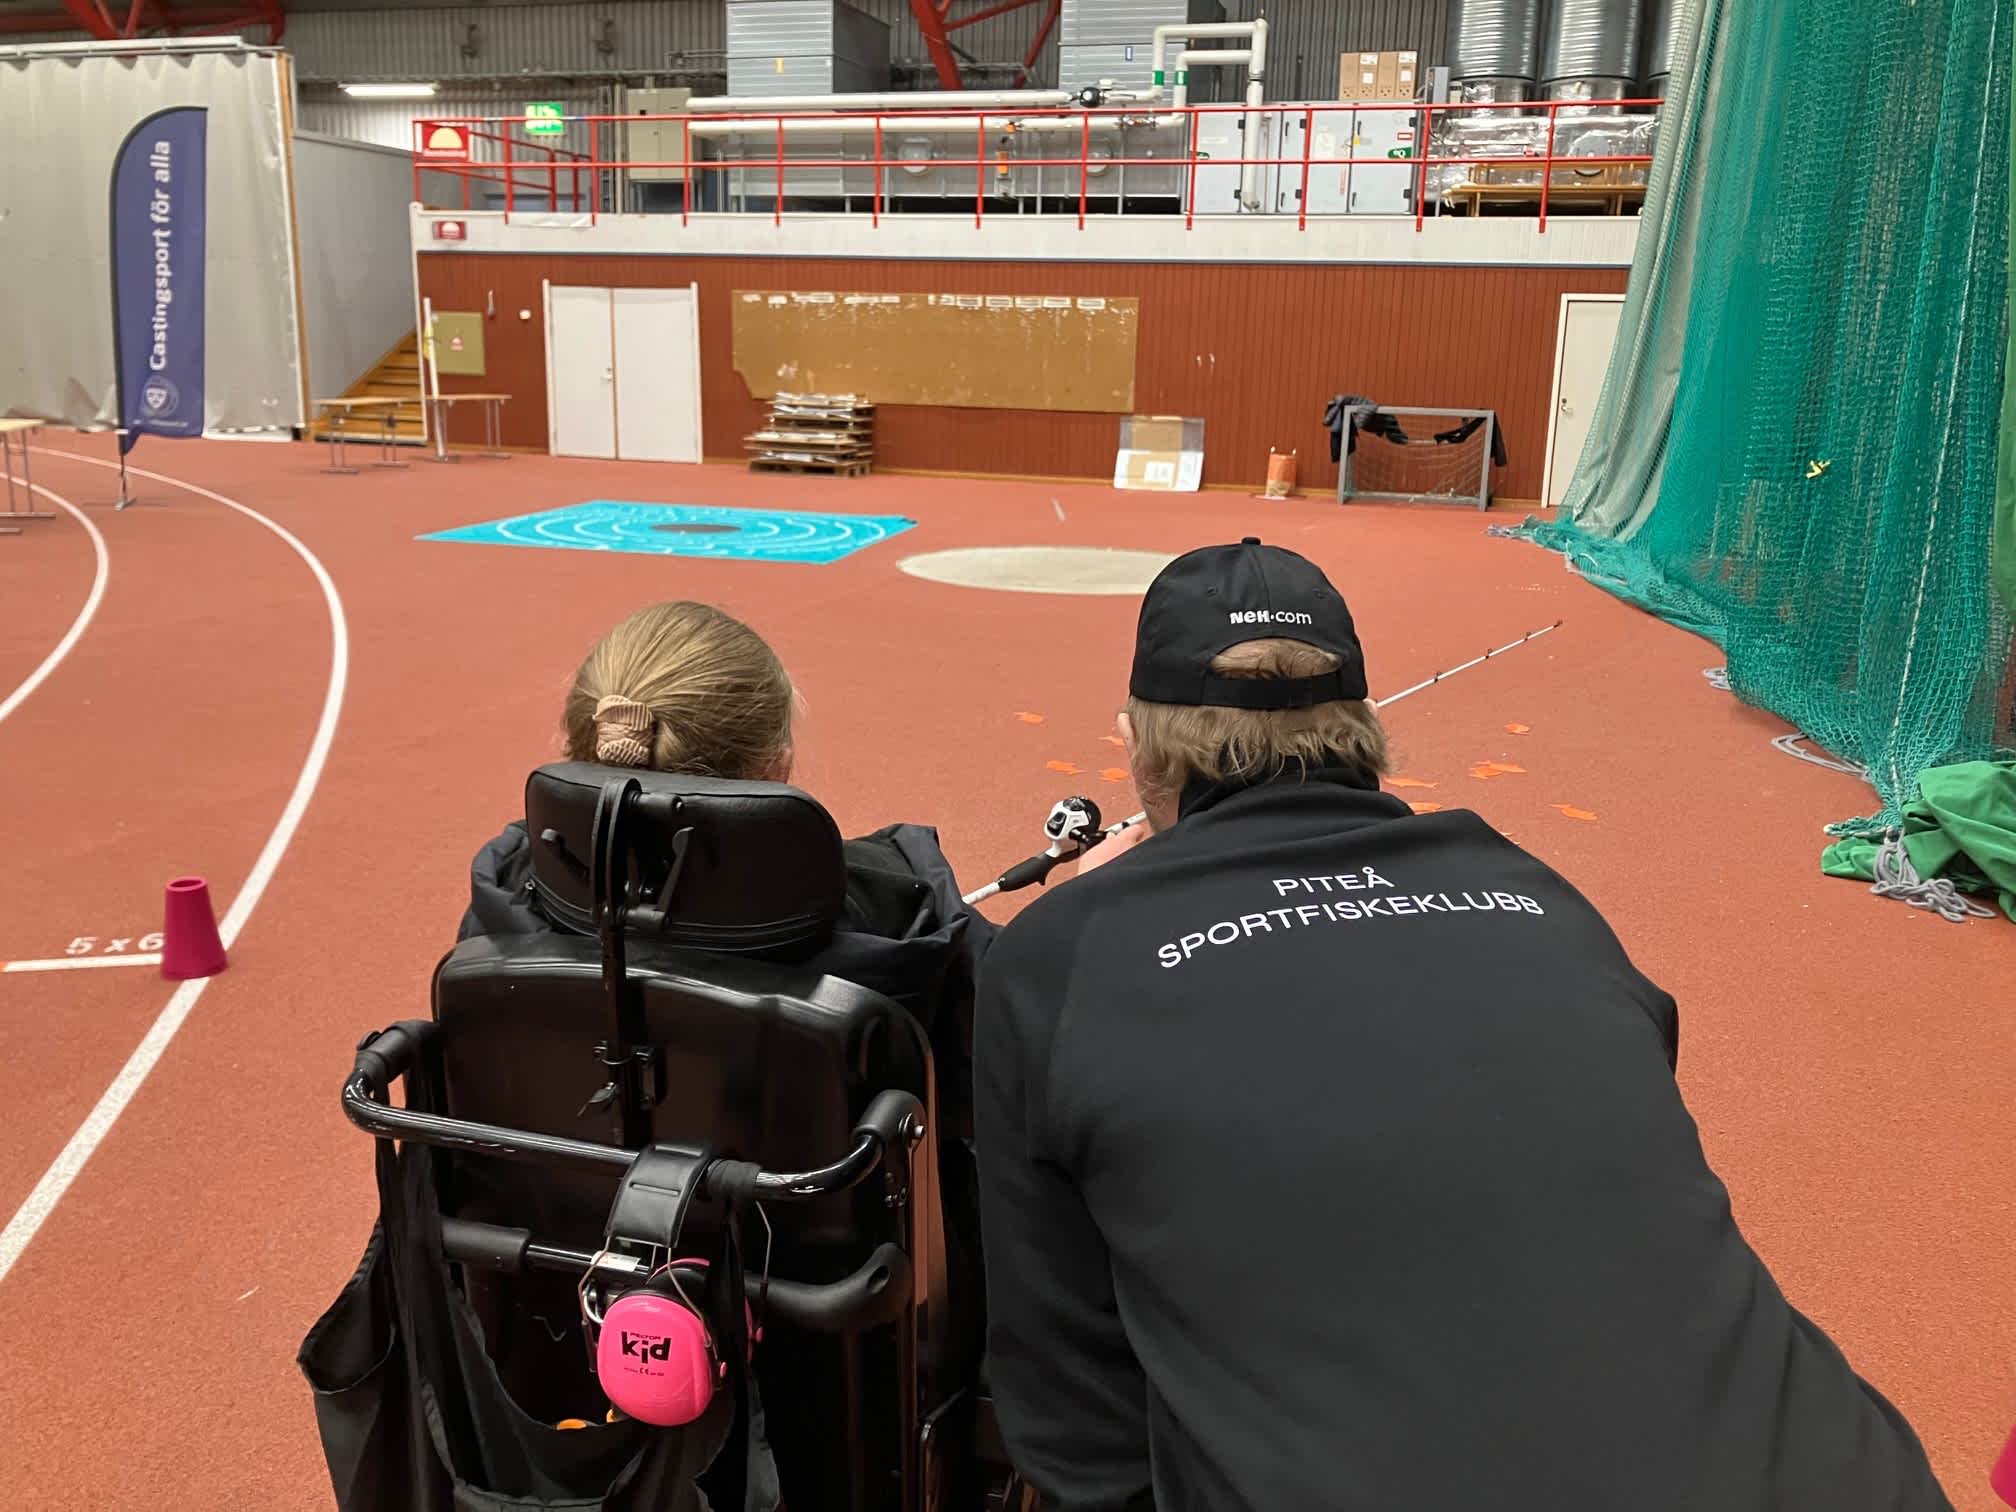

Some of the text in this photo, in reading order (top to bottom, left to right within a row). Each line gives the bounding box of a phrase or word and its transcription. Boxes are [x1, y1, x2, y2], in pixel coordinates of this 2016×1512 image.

[149, 140, 172, 371] Castingsport för alla
[1272, 866, 1395, 897] PITEÅ
[65, 936, 97, 955] 5
[1157, 891, 1545, 969] SPORTFISKEKLUBB
[621, 1331, 672, 1364] kid
